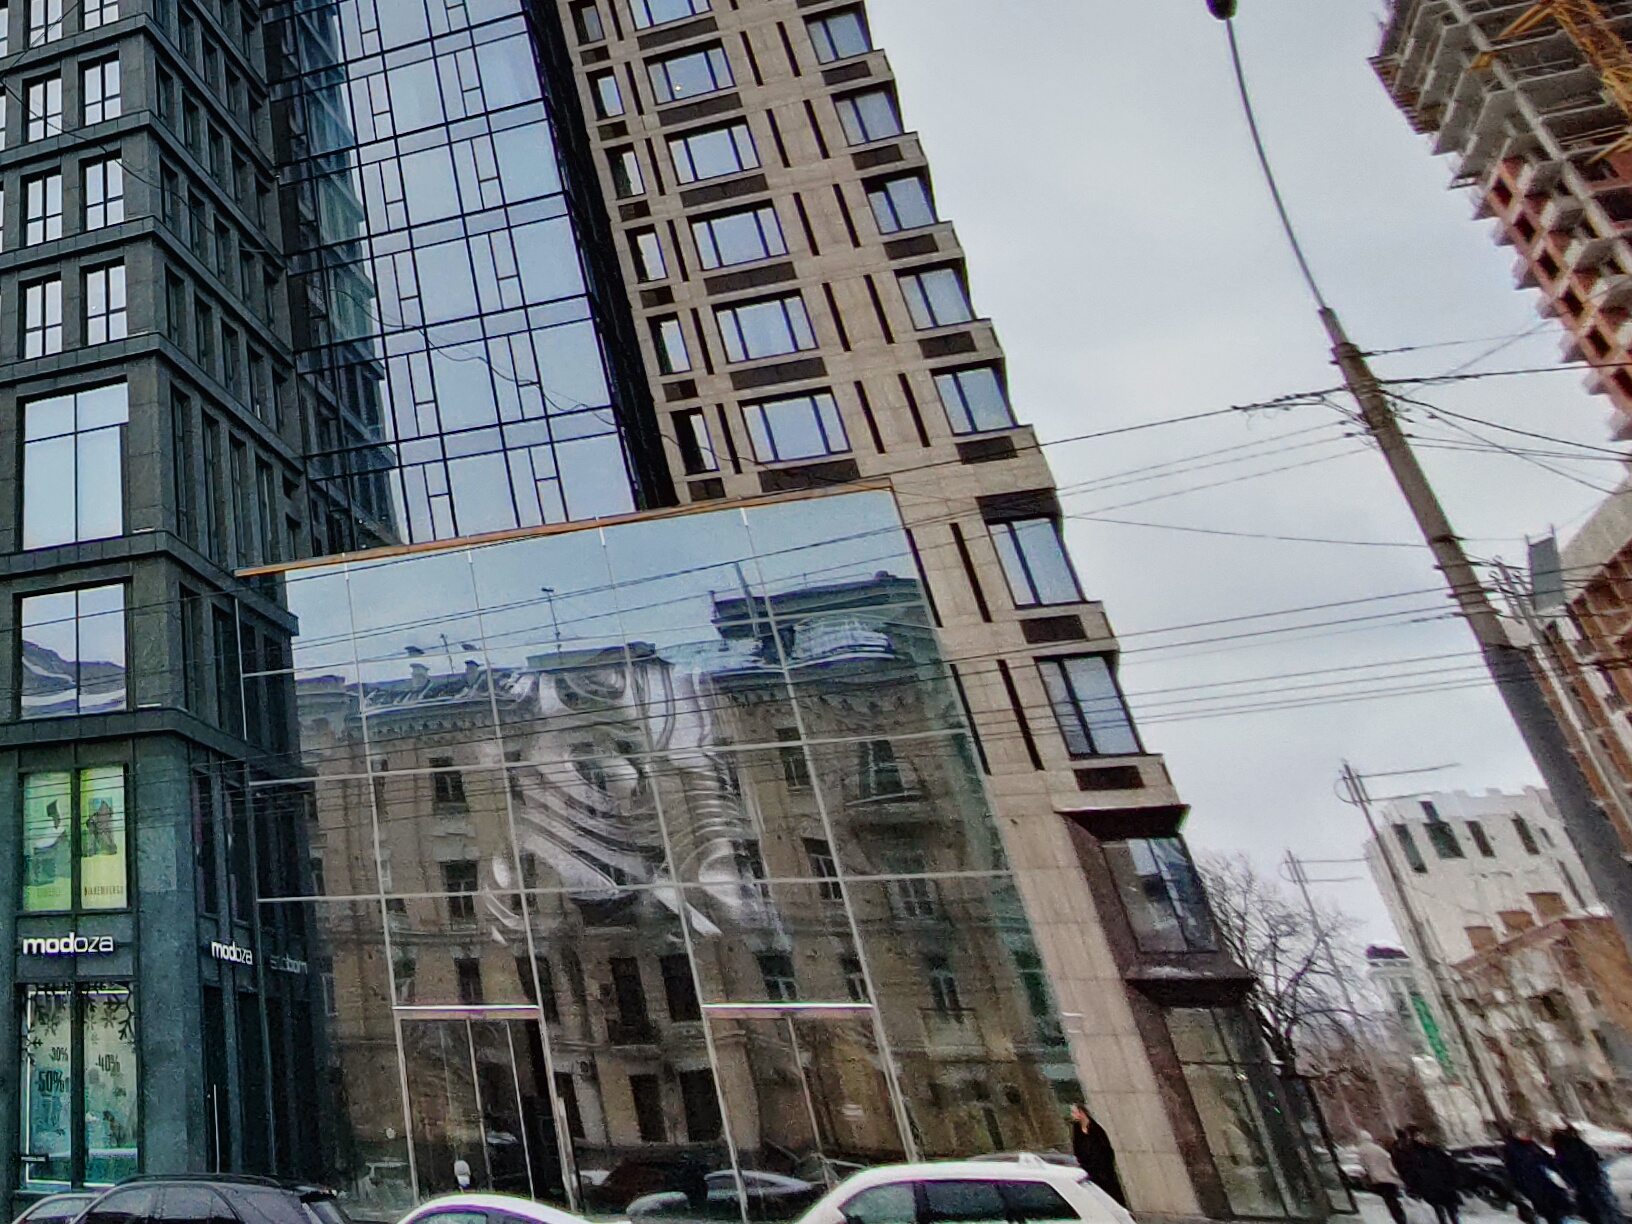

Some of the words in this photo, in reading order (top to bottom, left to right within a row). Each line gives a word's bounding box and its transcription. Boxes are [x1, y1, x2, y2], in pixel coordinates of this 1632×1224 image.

[23, 932, 114, 955] modoza
[211, 941, 254, 966] modoza
[35, 1070, 65, 1093] -50%
